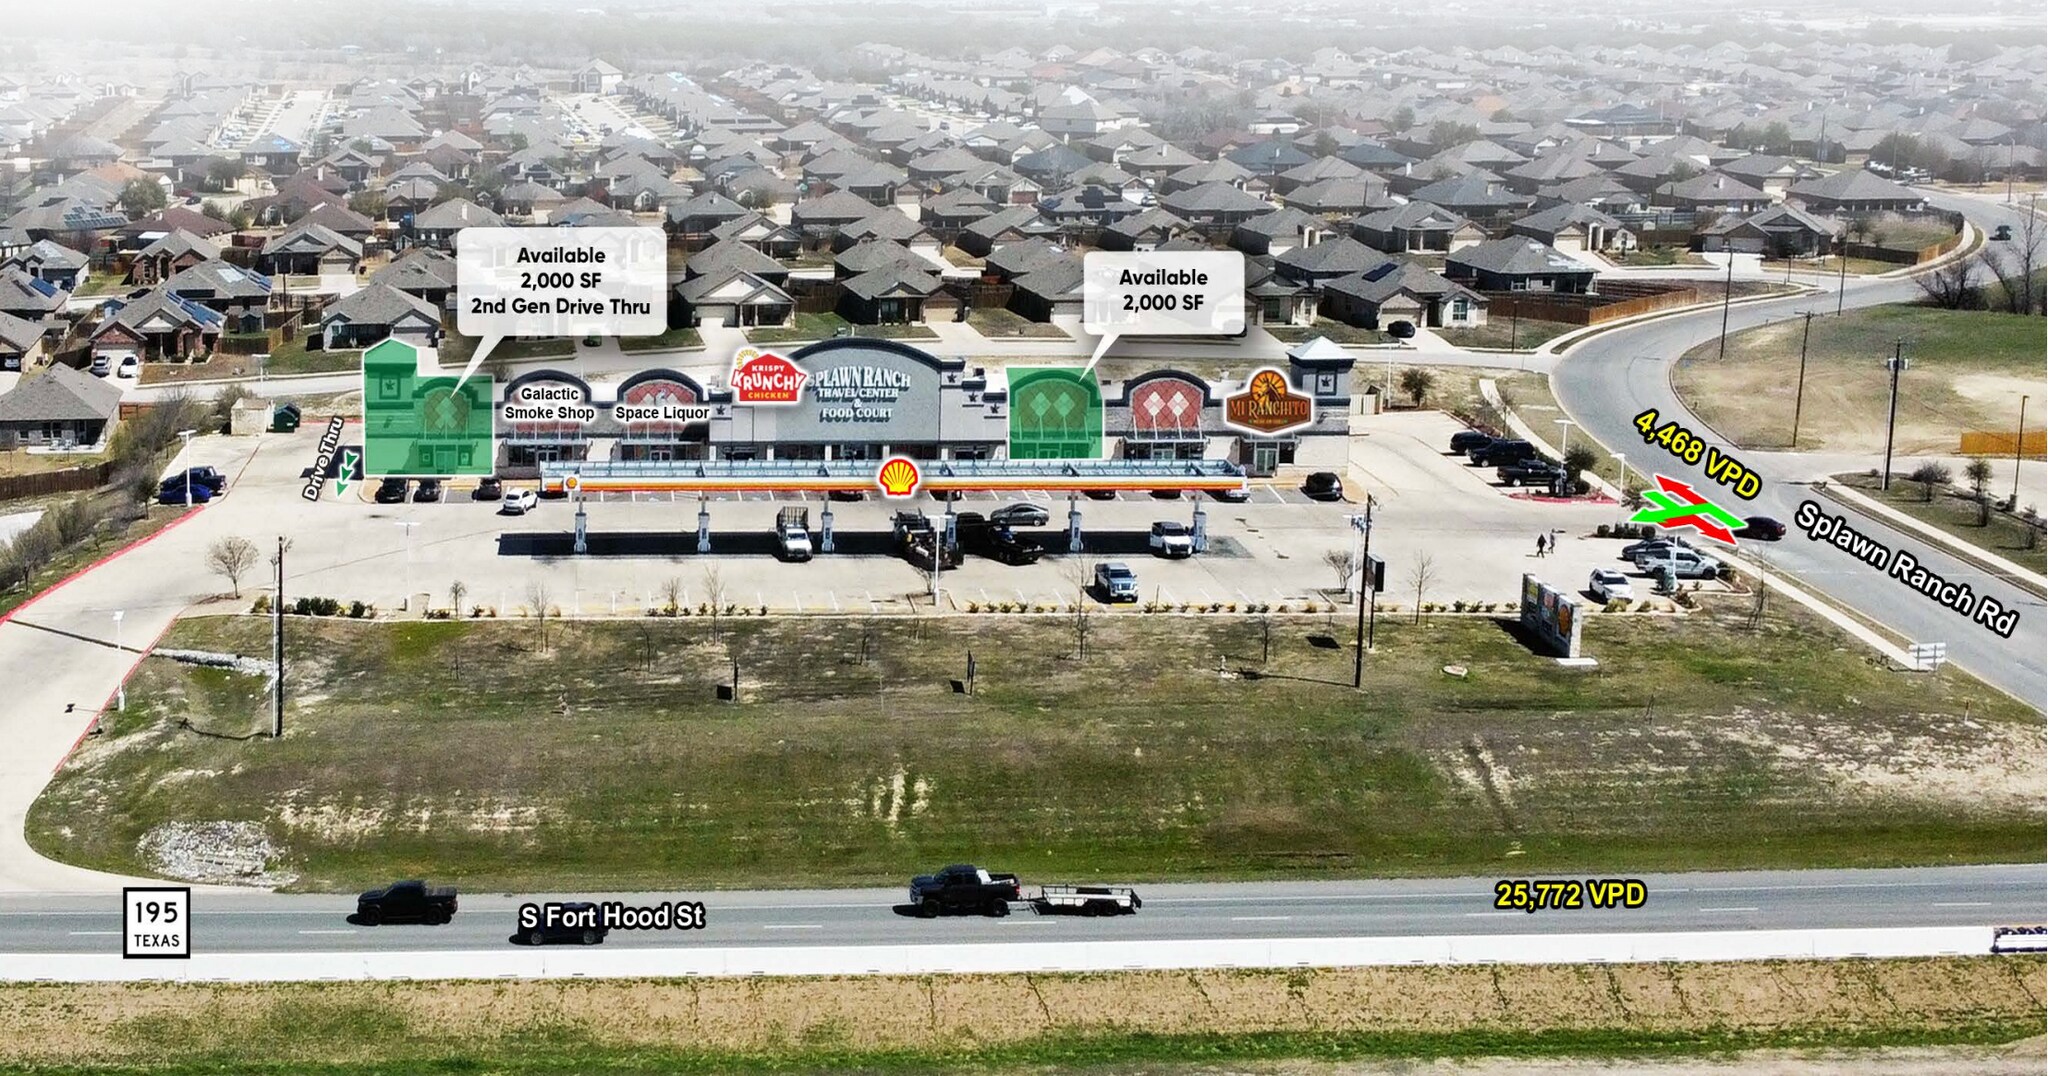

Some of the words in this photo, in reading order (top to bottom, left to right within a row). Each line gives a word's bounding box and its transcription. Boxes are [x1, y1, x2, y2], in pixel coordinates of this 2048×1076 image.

[807, 365, 862, 387] SPLAWN
[863, 365, 911, 388] RANCH
[853, 398, 863, 408] &
[822, 408, 855, 418] FOOD
[855, 408, 893, 418] COURT
